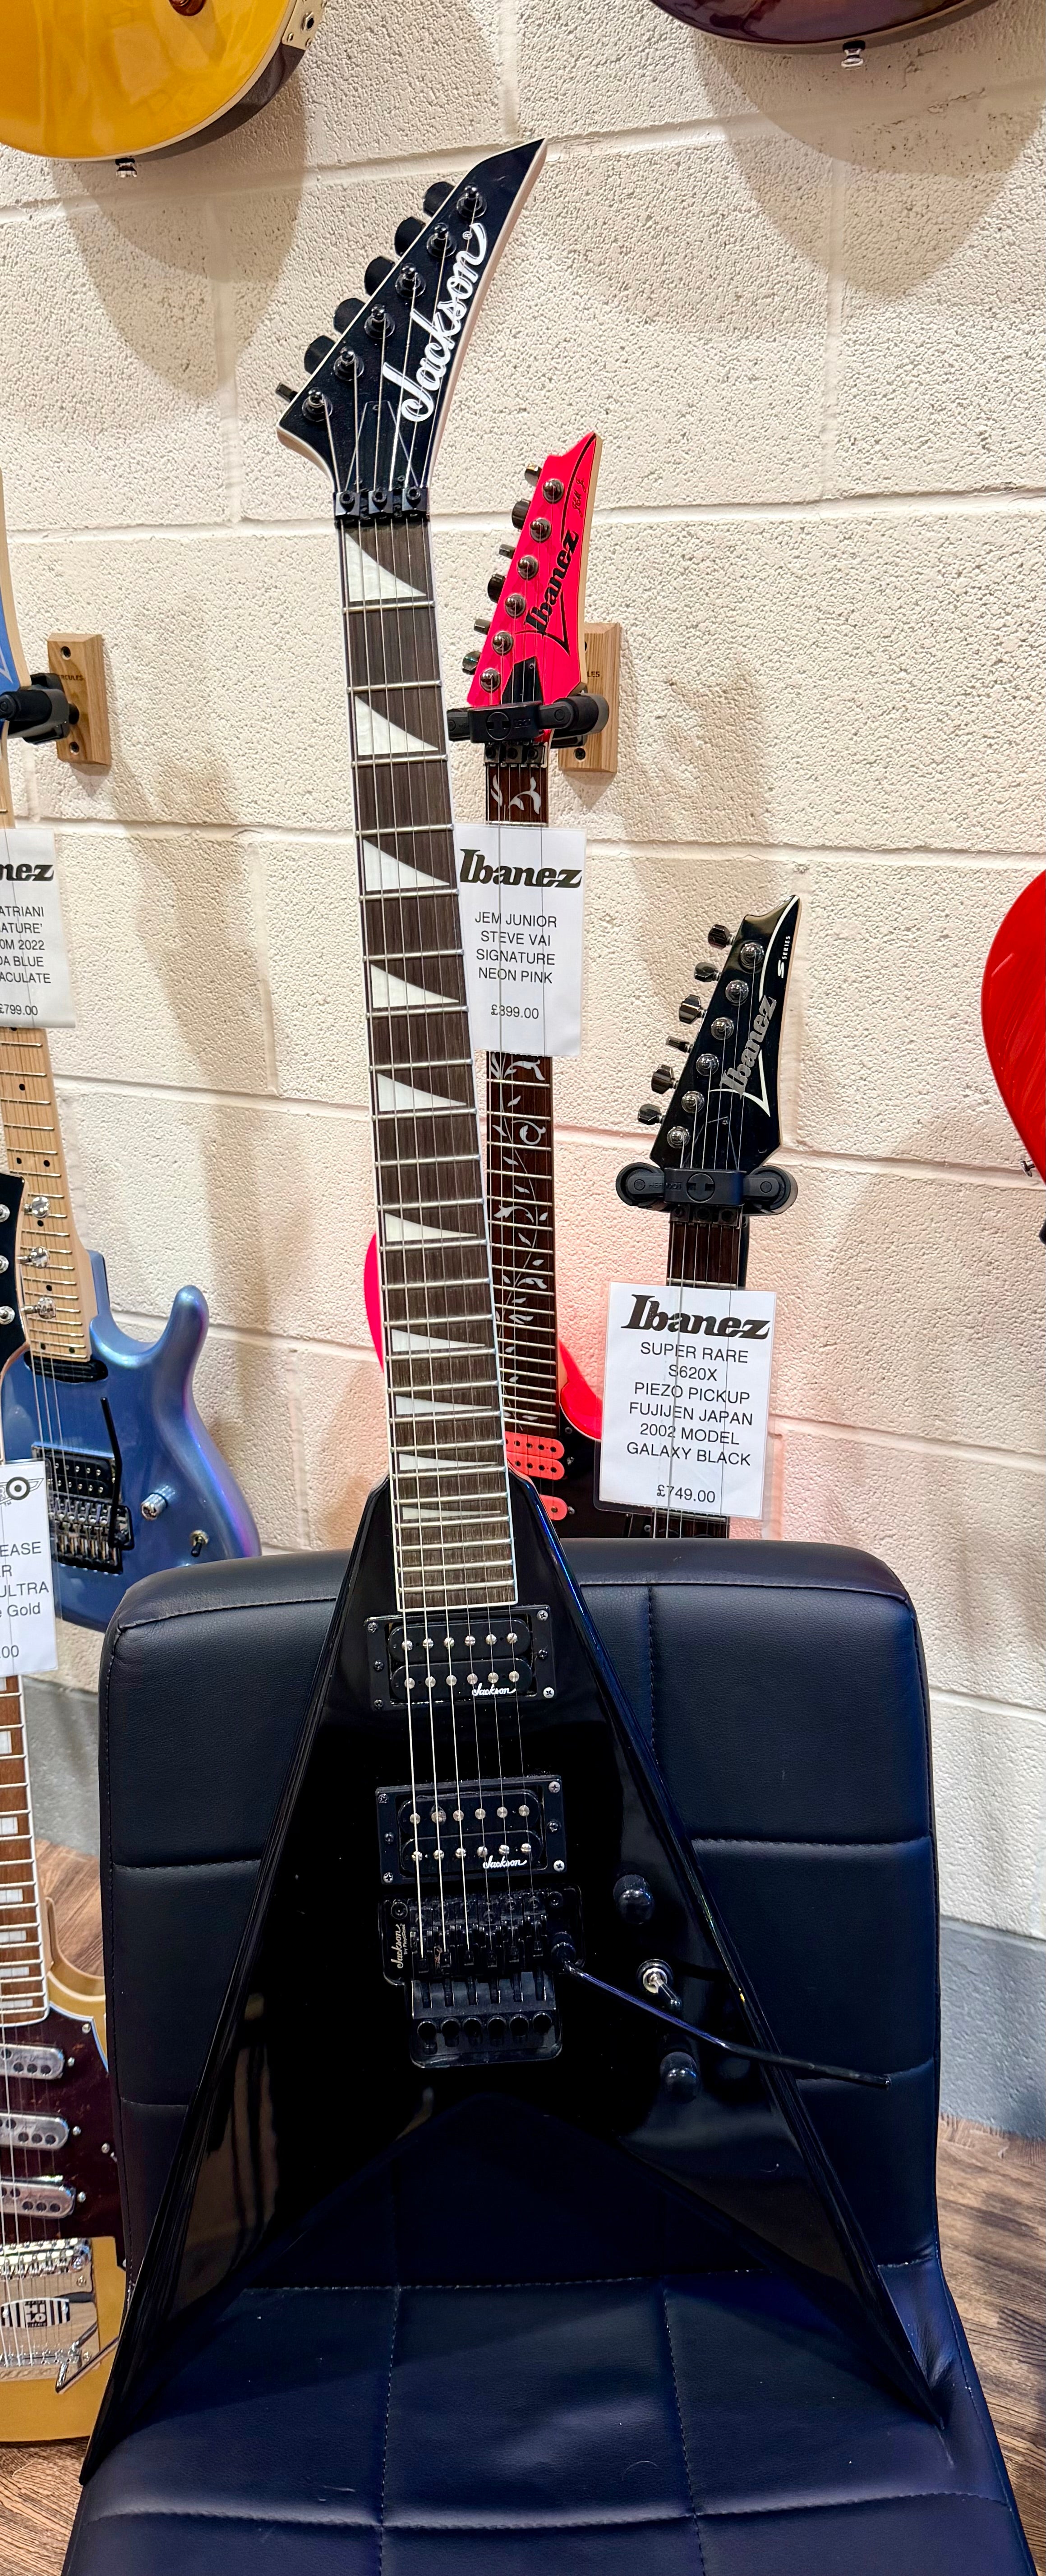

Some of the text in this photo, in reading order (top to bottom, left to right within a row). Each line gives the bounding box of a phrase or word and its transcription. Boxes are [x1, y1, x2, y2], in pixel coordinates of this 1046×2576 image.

[383, 222, 487, 423] Jackson
[523, 529, 579, 637] Ibanez
[460, 848, 582, 889] Ibanez
[0, 922, 42, 934] ATURE'
[475, 912, 557, 928] JEM JUNIOR
[18, 939, 45, 950] 2022
[481, 931, 551, 946] STEVE VAI
[782, 936, 791, 960] SERIES
[13, 956, 44, 967] BLUE
[476, 949, 555, 965] SIGNATURE
[479, 967, 553, 984] NEON PINK
[719, 994, 777, 1099] Ibanez
[621, 1294, 771, 1340] Ibanez
[641, 1342, 749, 1363] SUPER RARE
[668, 1364, 718, 1381] S620X
[635, 1382, 751, 1405] PIEZO PICKUP
[629, 1402, 753, 1426] FUJIJEN JAPAN
[640, 1423, 740, 1445] 2002 MODEL
[627, 1442, 751, 1466] GALAXY BLACK
[656, 1484, 716, 1503] £749.00
[0, 1581, 49, 1597] ULTRA
[7, 1602, 40, 1617] Gold
[471, 1683, 516, 1696] Jackson
[483, 1855, 527, 1868] Jackson
[391, 1924, 404, 1969] Jackson
